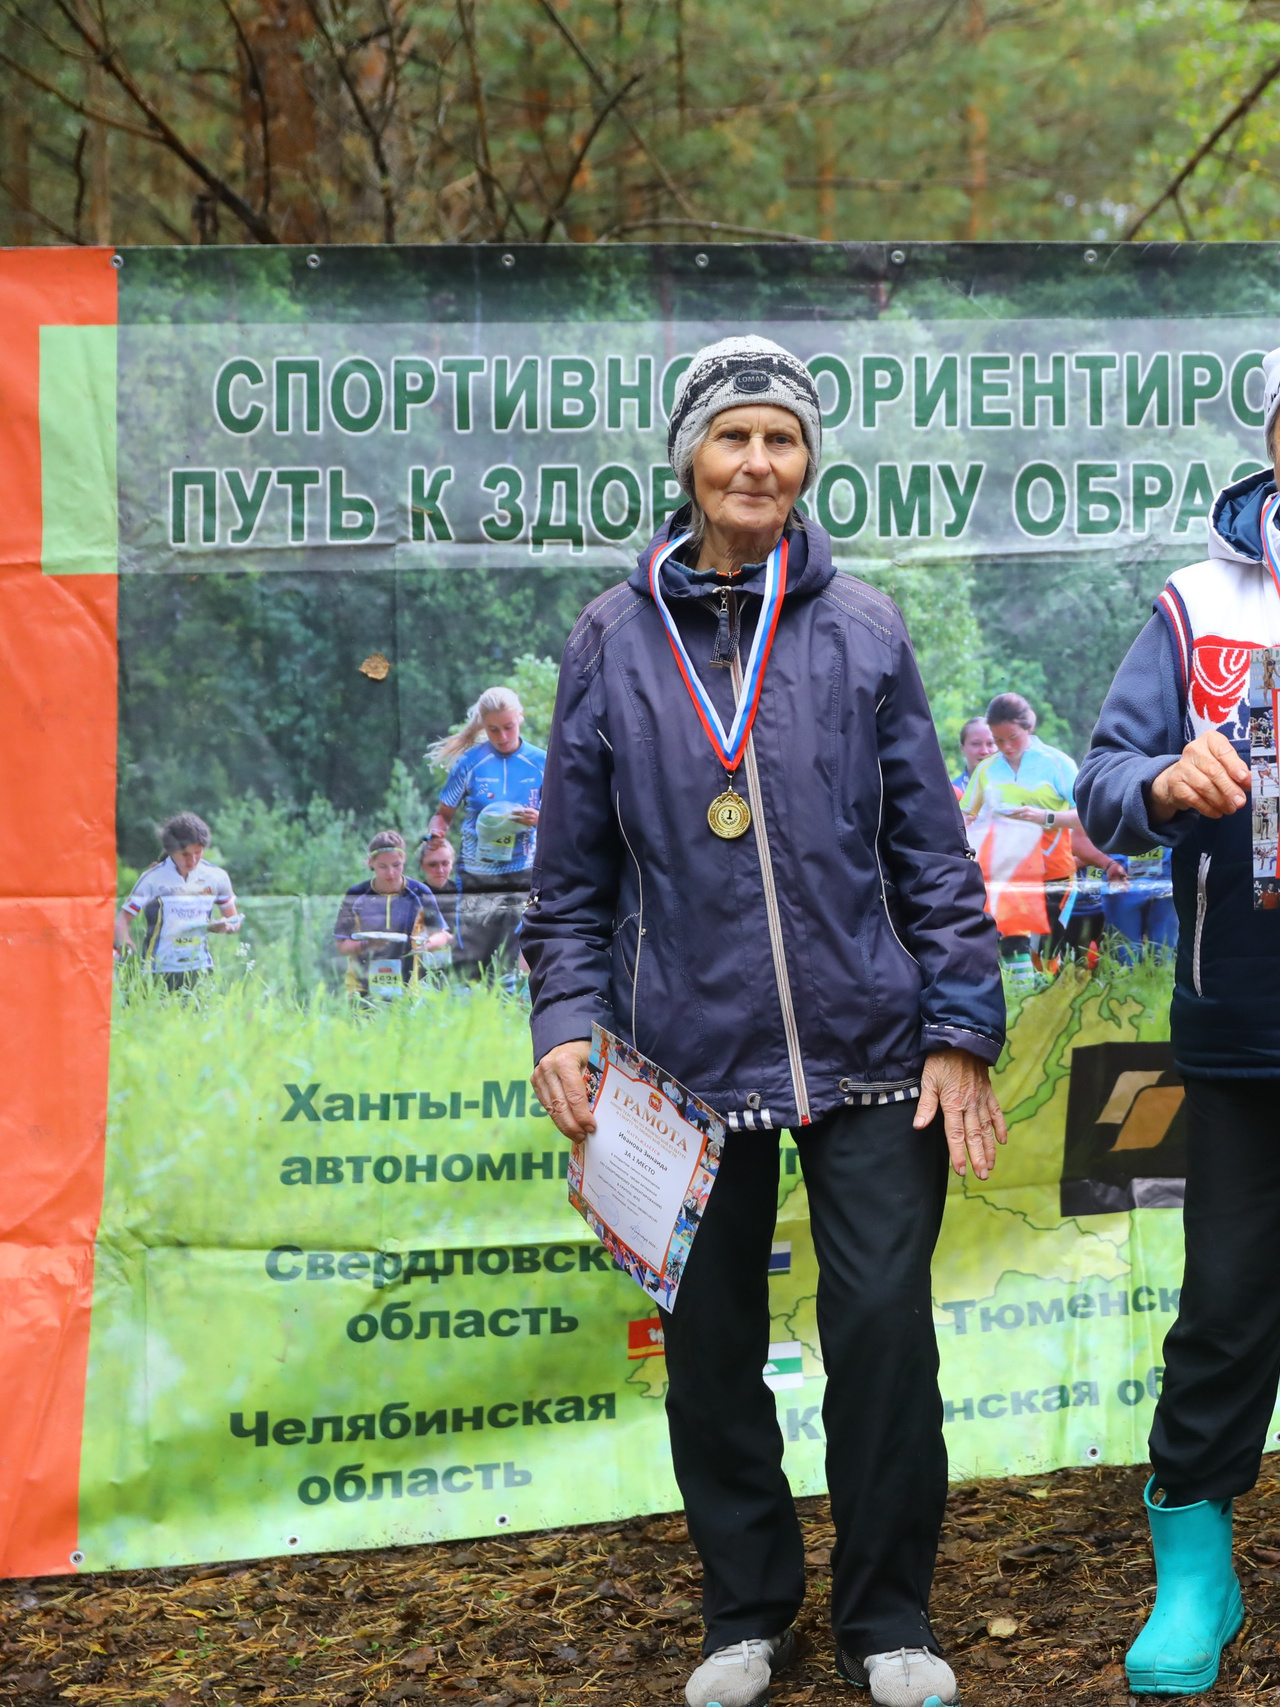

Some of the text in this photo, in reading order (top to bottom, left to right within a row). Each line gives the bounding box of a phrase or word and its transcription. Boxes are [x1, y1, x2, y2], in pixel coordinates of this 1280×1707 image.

[172, 469, 376, 543] ПУТЬ
[411, 468, 455, 541] К
[726, 810, 733, 820] 1
[614, 1086, 688, 1152] ГРАМОТА
[619, 1131, 667, 1172] Иванова Зинаида
[624, 1149, 631, 1158] ЗА
[636, 1158, 656, 1176] МЕСТО
[265, 1244, 624, 1289] Свердловск
[346, 1301, 579, 1343] область
[229, 1392, 617, 1447] Челябинская
[298, 1460, 533, 1506] область
